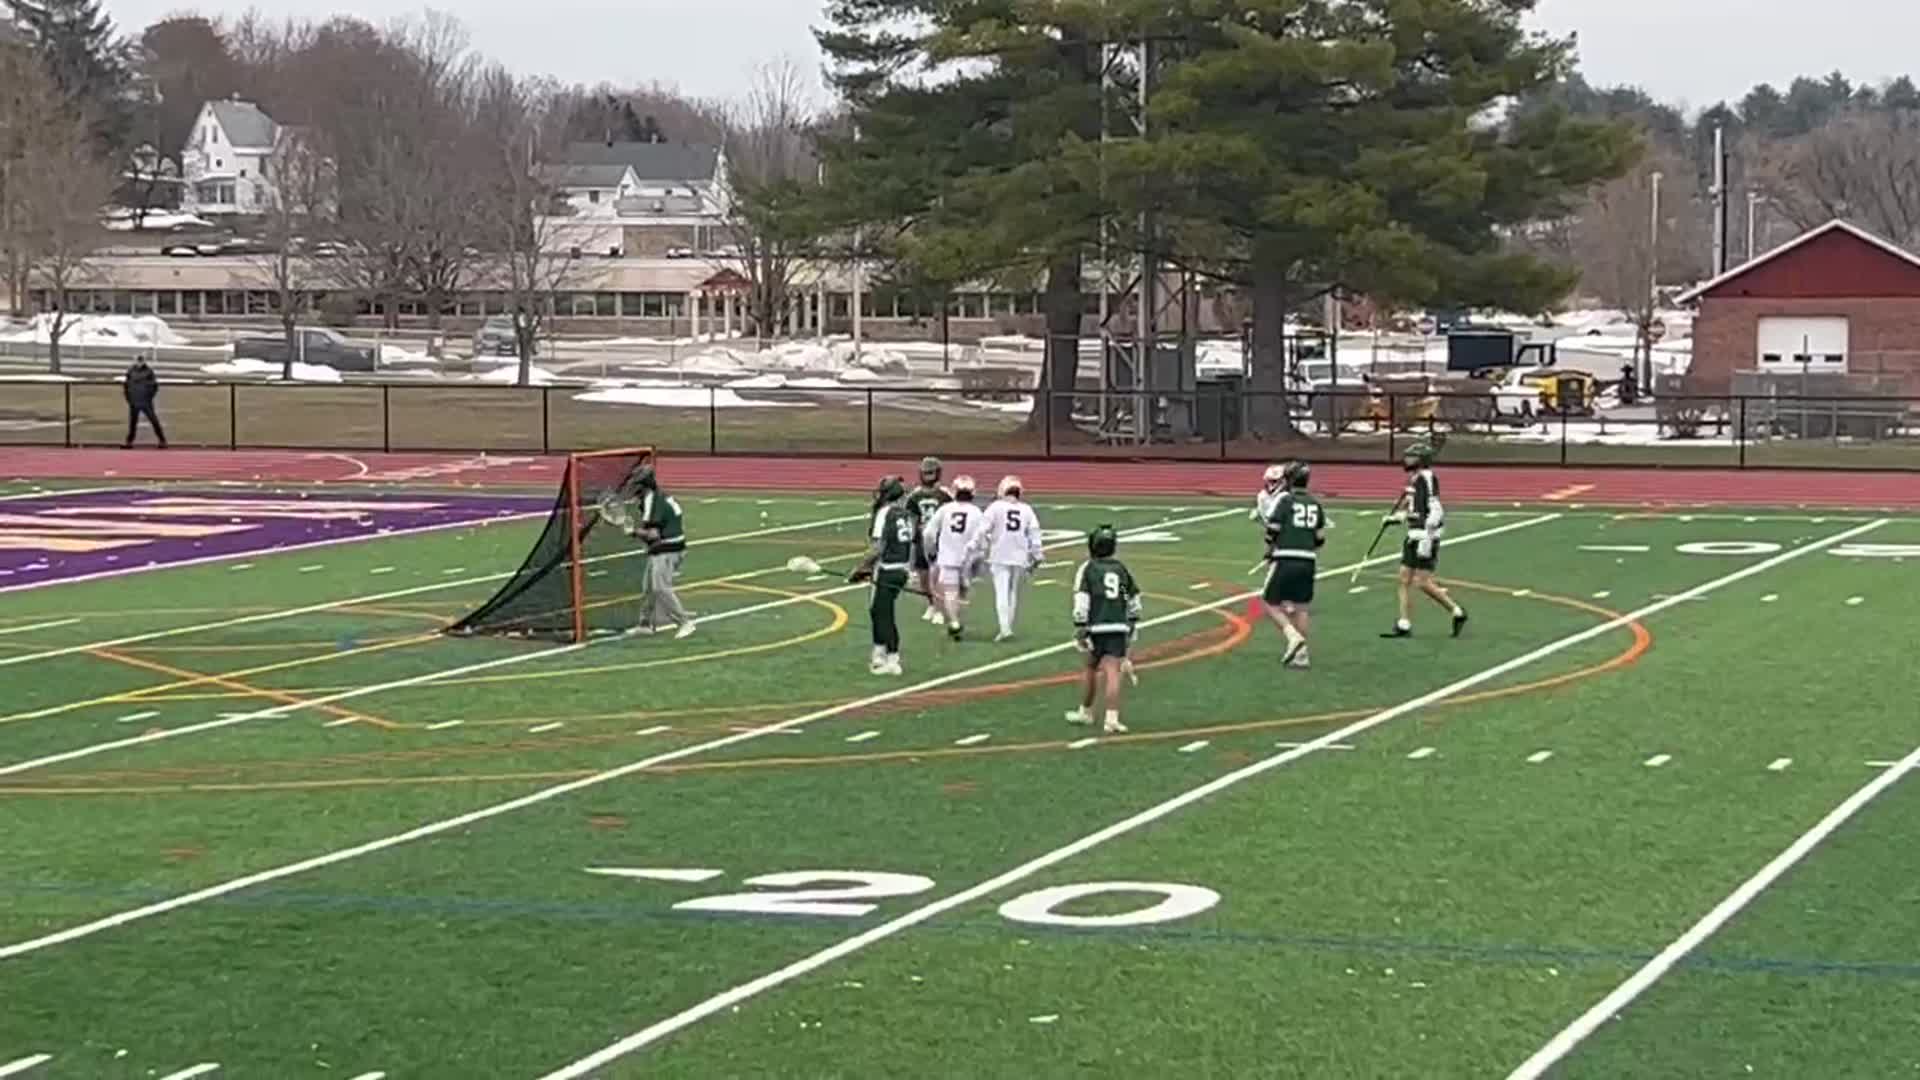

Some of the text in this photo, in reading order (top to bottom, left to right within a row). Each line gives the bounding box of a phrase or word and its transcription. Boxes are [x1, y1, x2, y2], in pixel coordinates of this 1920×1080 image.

[950, 511, 968, 533] 3
[1006, 510, 1021, 532] 5
[1292, 502, 1318, 528] 25
[1104, 572, 1119, 599] 9
